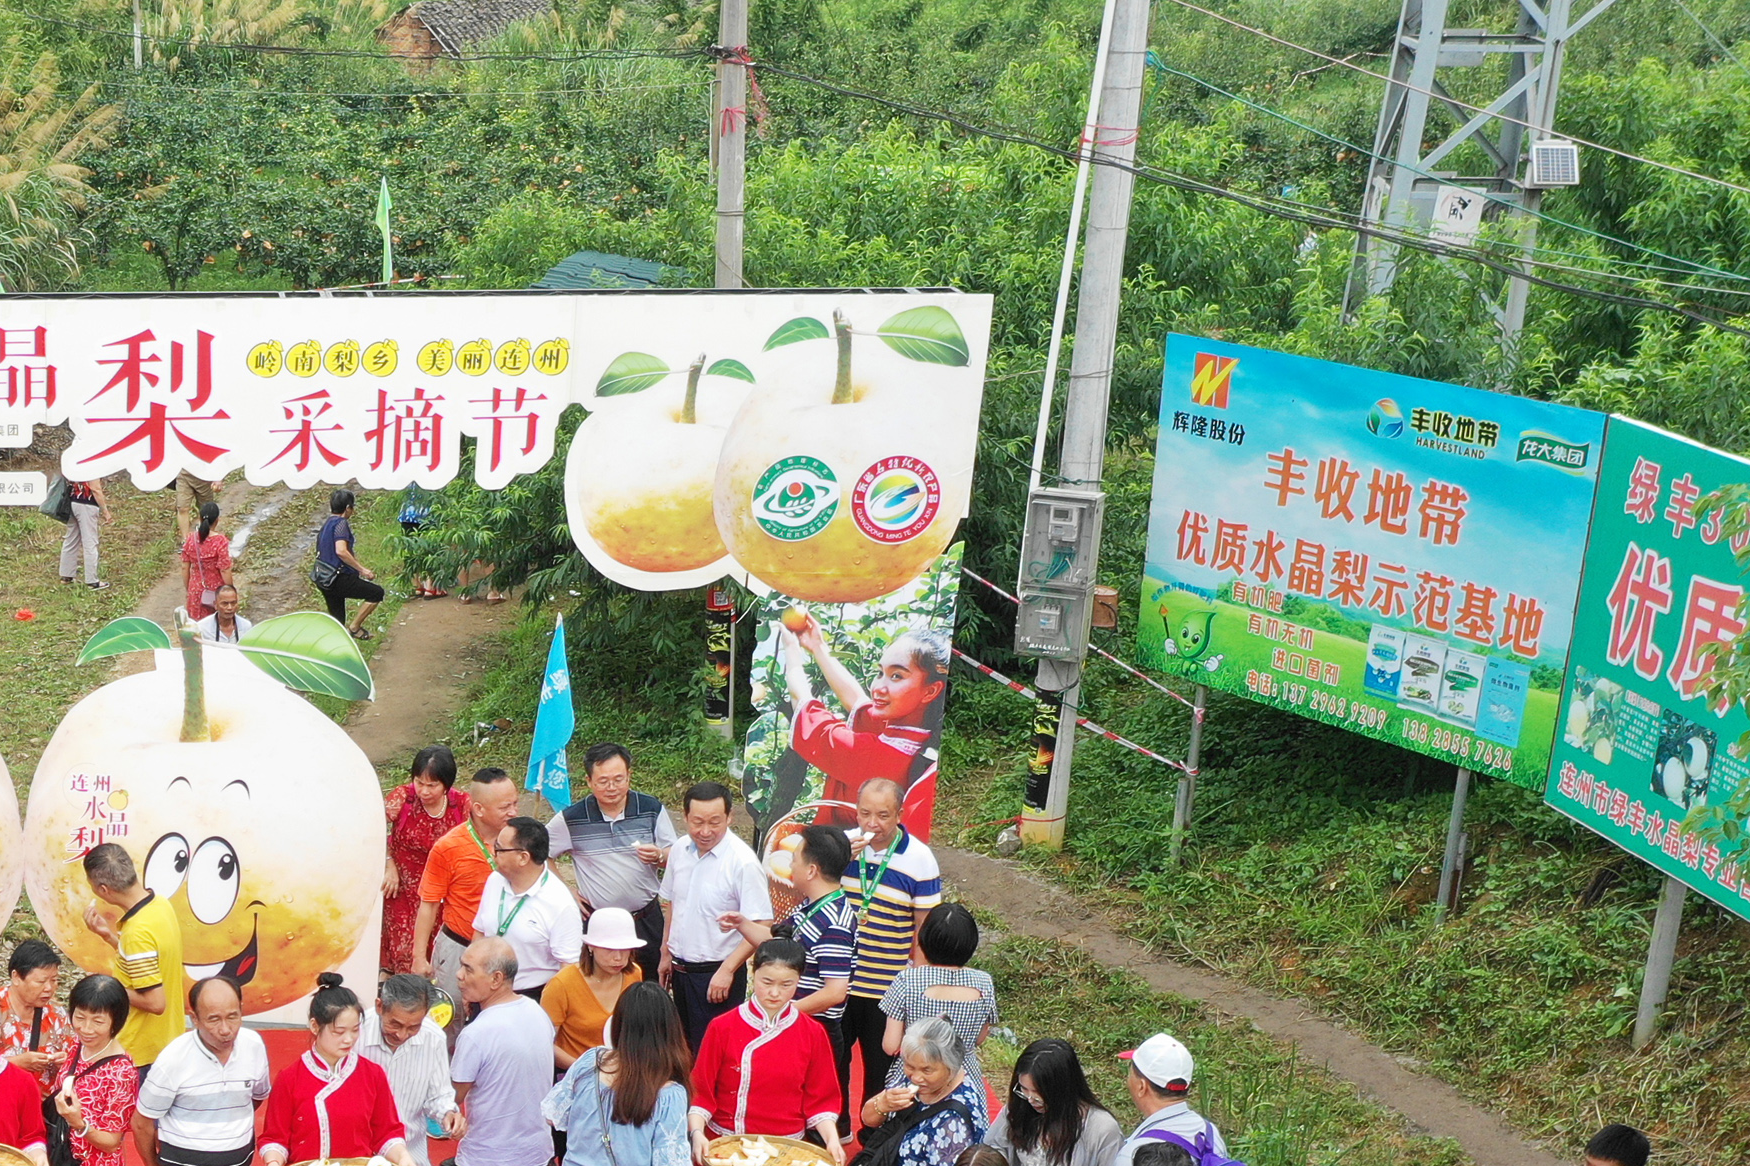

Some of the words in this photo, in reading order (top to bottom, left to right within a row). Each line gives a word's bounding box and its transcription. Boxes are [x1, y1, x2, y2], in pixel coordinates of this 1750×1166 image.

[254, 347, 390, 374] 岭南梨乡
[423, 347, 561, 373] 美丽连州
[1172, 410, 1246, 446] 辉隆股份
[1410, 407, 1500, 447] 丰收地带
[1415, 436, 1486, 460] HARVESTLAND
[1263, 447, 1468, 546] 丰收地带
[1176, 508, 1545, 658] 优质水晶梨示范基地
[1233, 580, 1283, 613] 有机肥
[1248, 613, 1314, 650] 有机无机
[1272, 649, 1340, 686] 进口菌剂
[1282, 681, 1307, 705] 137
[1309, 690, 1346, 718] 2962
[1350, 702, 1387, 731] 9209
[1402, 718, 1428, 744] 138
[1431, 727, 1472, 757] 2855
[1474, 741, 1512, 771] 7626
[70, 773, 111, 793] 连州
